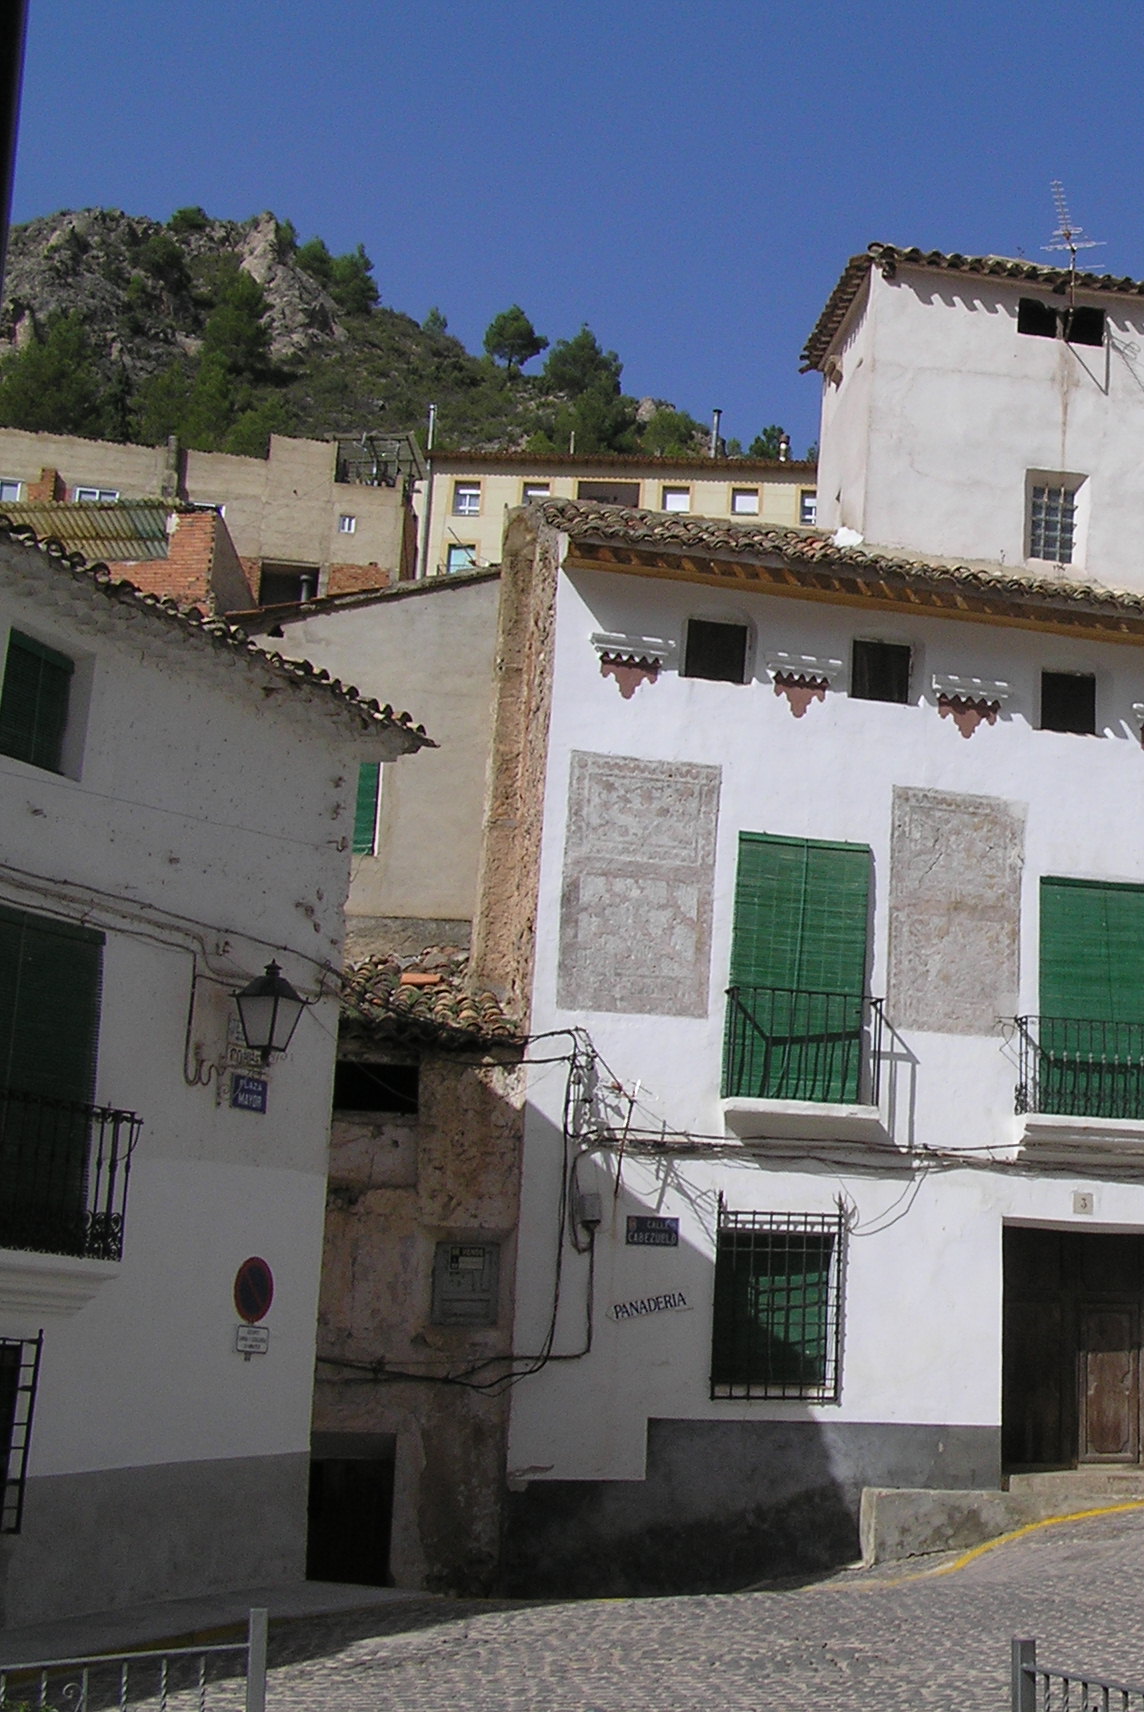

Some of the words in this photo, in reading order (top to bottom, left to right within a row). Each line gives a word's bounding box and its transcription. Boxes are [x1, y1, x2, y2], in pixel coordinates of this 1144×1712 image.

[239, 1079, 262, 1091] PLAZA
[238, 1093, 262, 1107] MAYOR
[1080, 1197, 1088, 1210] 3
[647, 1219, 670, 1230] CALLE
[613, 1291, 687, 1319] PANADERIA
